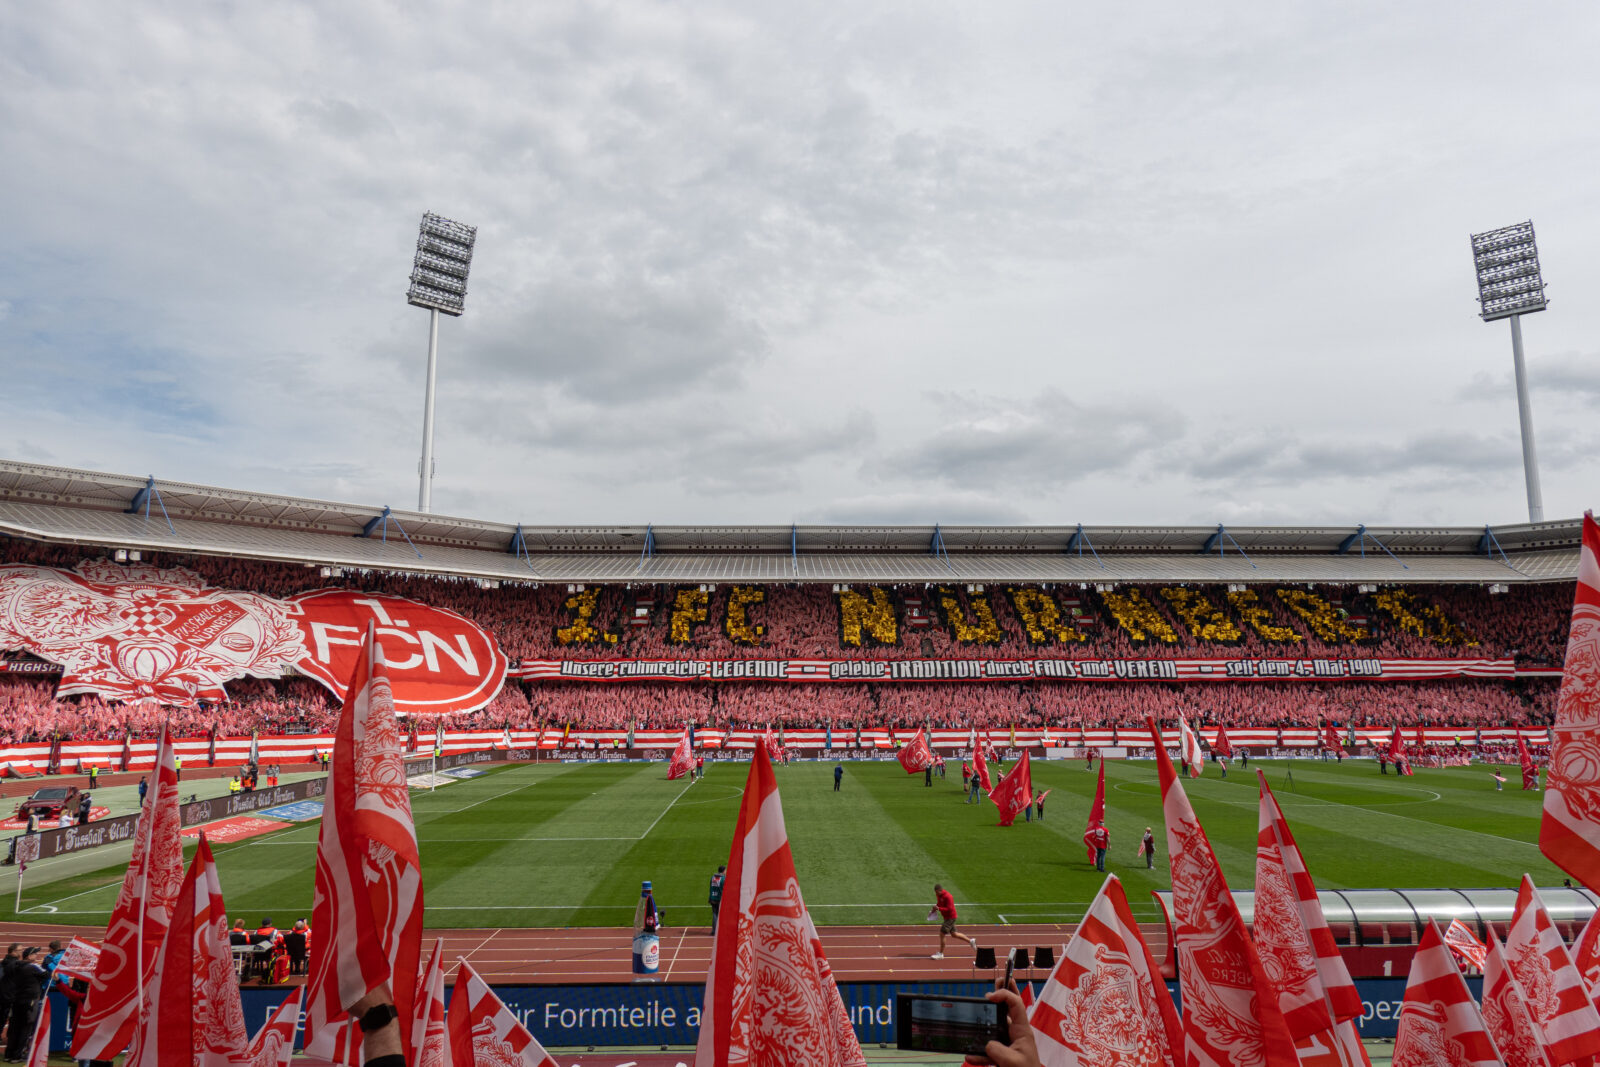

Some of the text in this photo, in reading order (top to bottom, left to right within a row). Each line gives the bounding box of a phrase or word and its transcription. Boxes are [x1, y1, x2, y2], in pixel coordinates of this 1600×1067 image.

[354, 599, 410, 628] 1.
[310, 621, 481, 677] FCN
[562, 660, 614, 676] Unsere
[619, 660, 707, 676] ruhmreiche
[711, 660, 788, 678] LEGENDE
[830, 660, 886, 678] gelebte
[890, 660, 981, 678] TRADITION
[985, 660, 1030, 677] durch
[1034, 660, 1077, 678] FANS
[1081, 661, 1110, 677] und
[1114, 660, 1177, 679] VEREIN
[1226, 659, 1254, 676] seit
[1258, 659, 1290, 676] dem
[1295, 659, 1310, 675] 4.
[1313, 659, 1345, 676] Mai
[1349, 659, 1382, 676] 1900
[544, 1000, 677, 1029] Formteile
